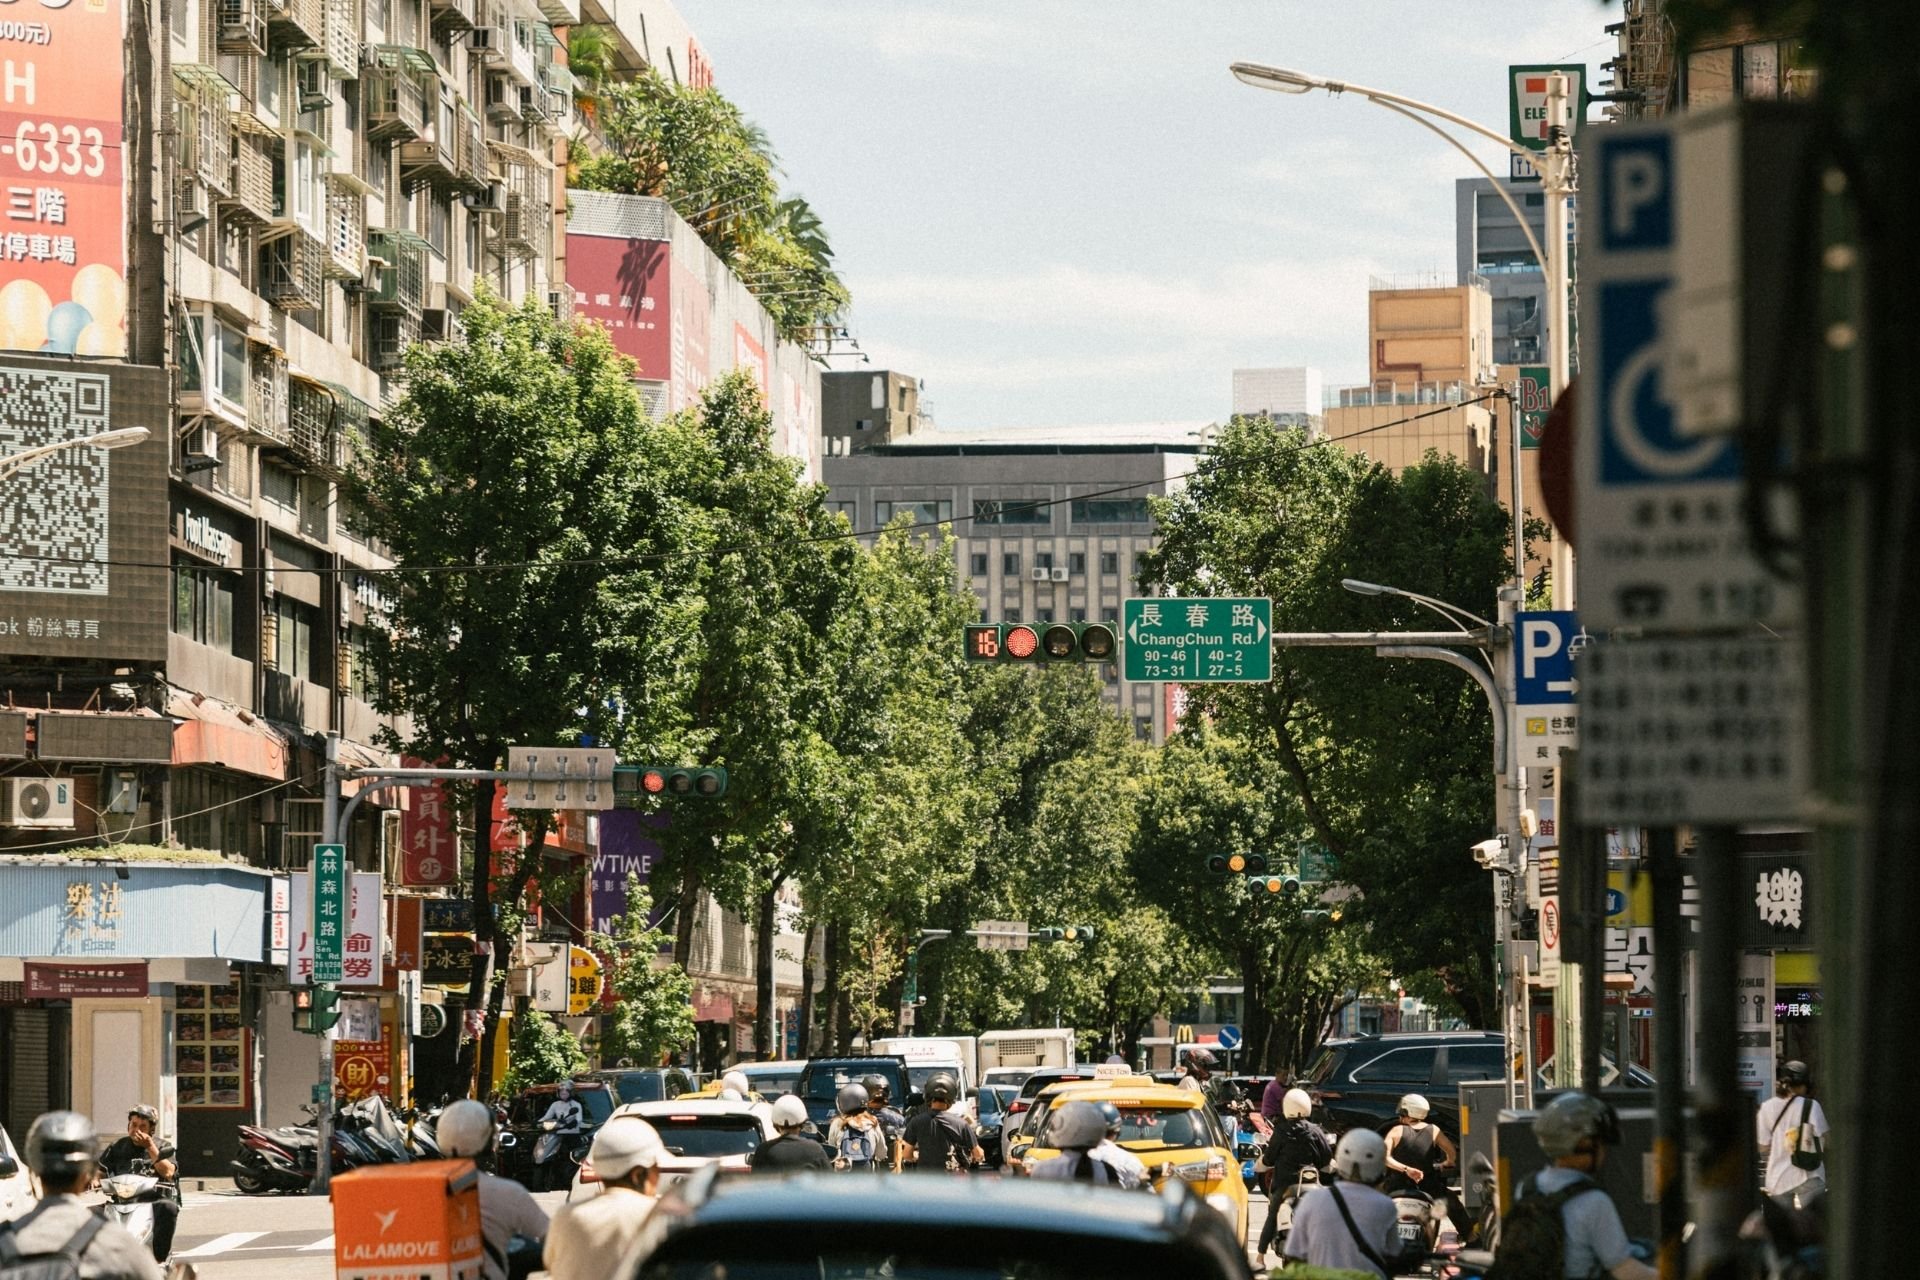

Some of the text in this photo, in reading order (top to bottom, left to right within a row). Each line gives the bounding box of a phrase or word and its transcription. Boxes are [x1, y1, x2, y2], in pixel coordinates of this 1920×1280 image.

[5, 60, 35, 105] H
[1138, 604, 1256, 627] 長春路
[978, 630, 996, 657] 16
[1138, 632, 1257, 648] ChangChun Rd.
[1523, 620, 1563, 679] P
[1144, 650, 1243, 662] 90-46 40-2
[1144, 665, 1243, 677] 73-31 27-5
[421, 862, 439, 877] 2F
[321, 858, 337, 937] 林森北路
[1755, 867, 1803, 930] 機
[342, 1241, 441, 1261] LALAMOVE
